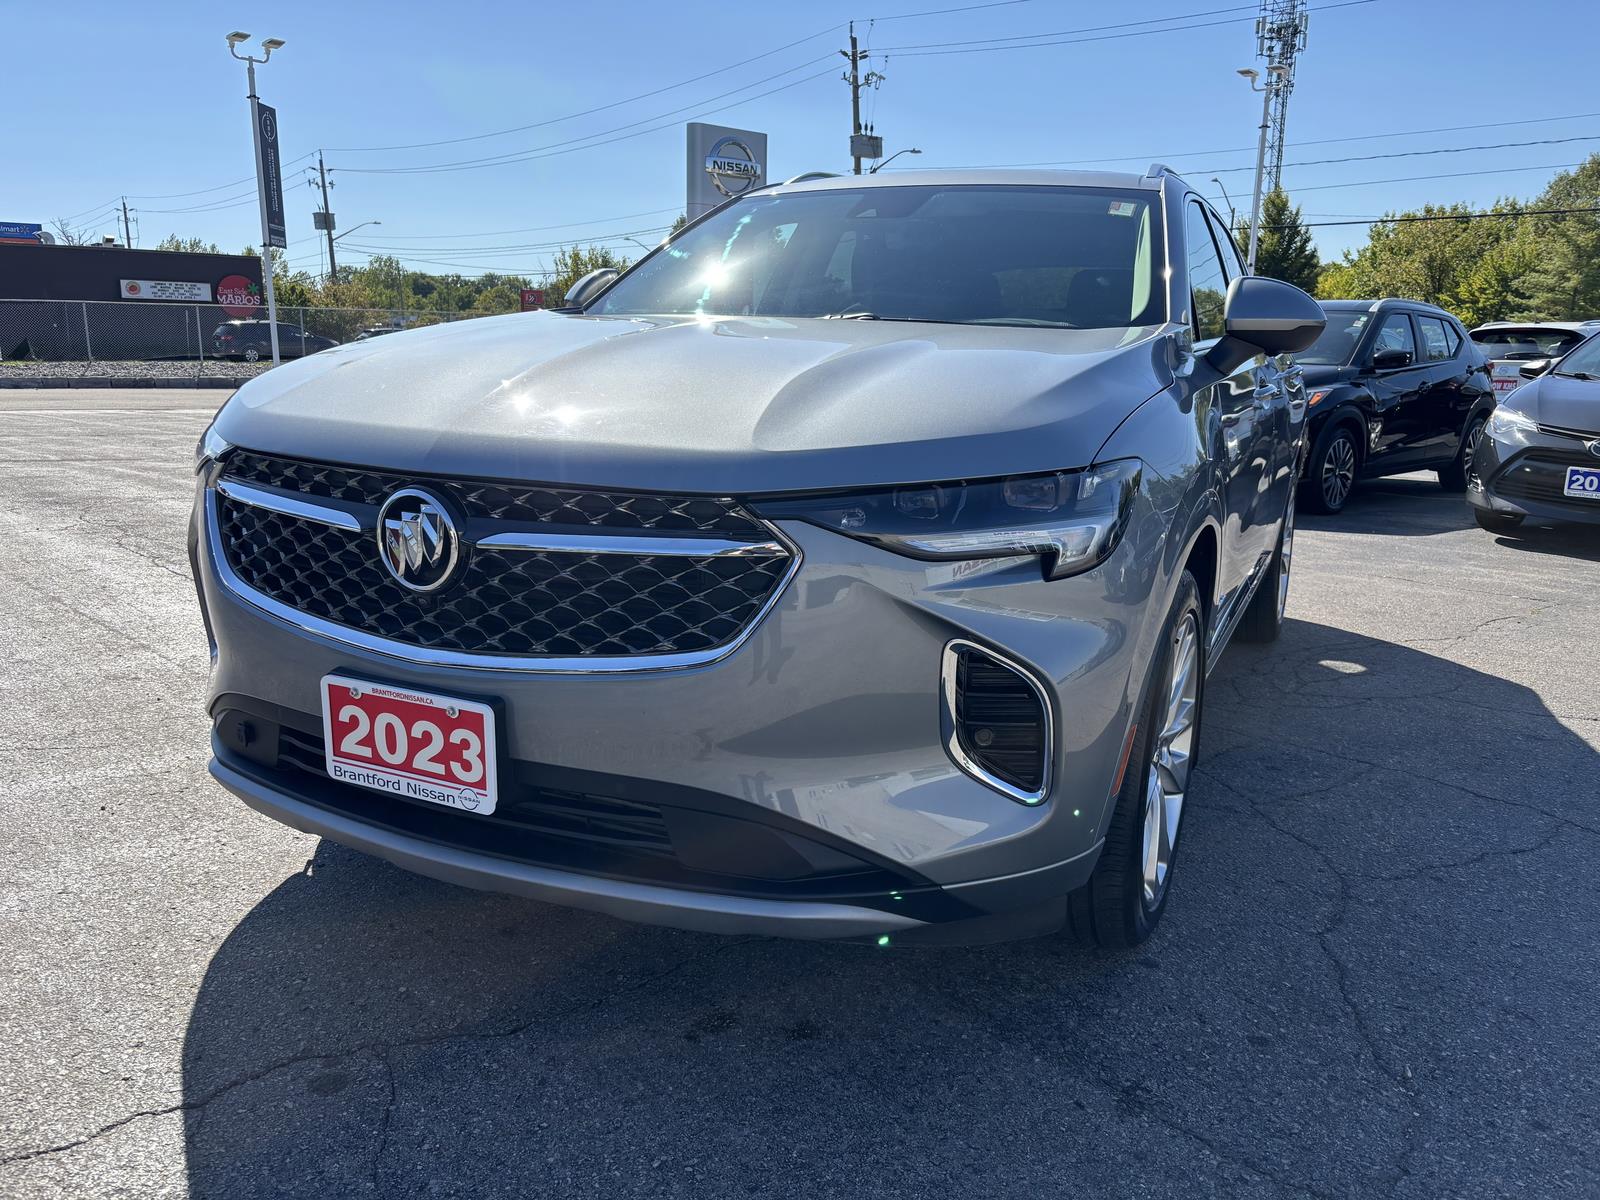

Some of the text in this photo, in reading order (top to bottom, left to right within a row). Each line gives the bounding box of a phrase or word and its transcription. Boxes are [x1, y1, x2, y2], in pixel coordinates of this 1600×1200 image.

[712, 160, 758, 175] NISSAN
[0, 225, 20, 233] lmart
[218, 286, 248, 295] East Side
[371, 687, 434, 705] BRANTFORDNISSAN.CA
[338, 704, 484, 783] 2023
[333, 765, 456, 804] Brantford Nissan
[457, 795, 481, 804] NISSAN
